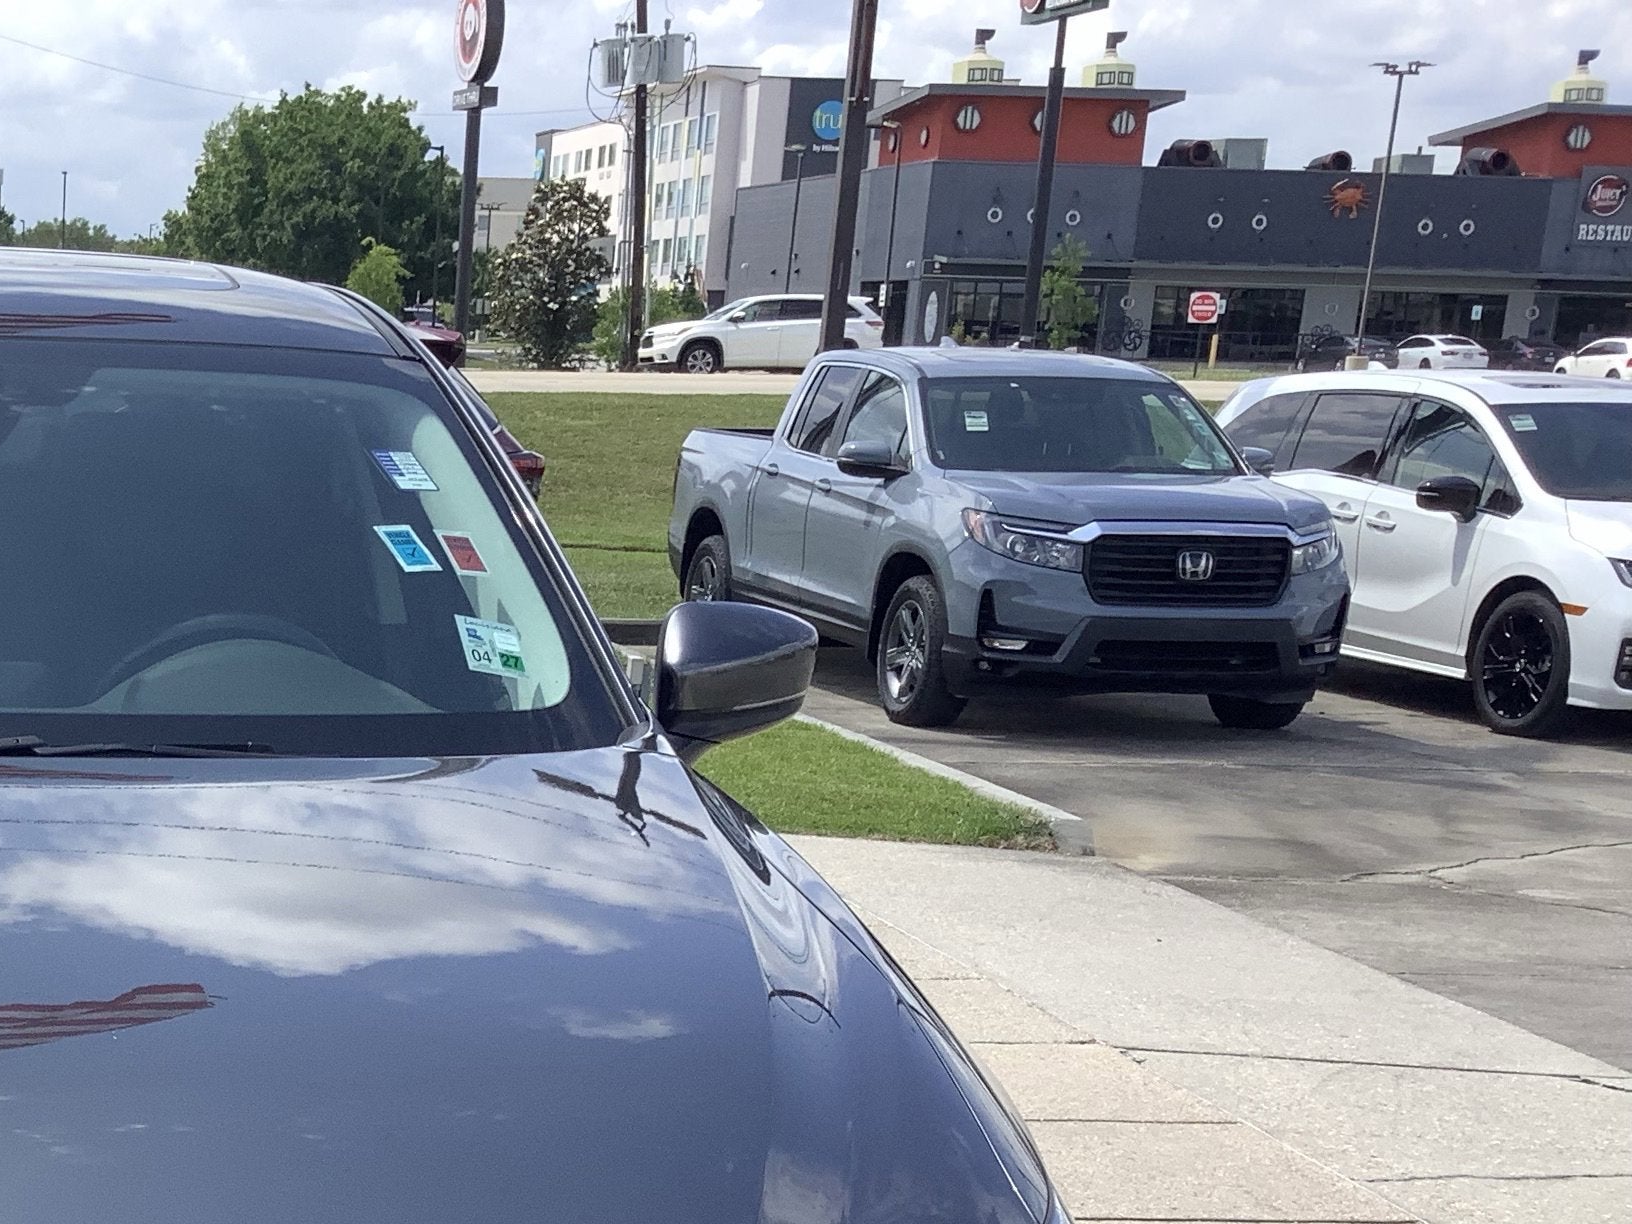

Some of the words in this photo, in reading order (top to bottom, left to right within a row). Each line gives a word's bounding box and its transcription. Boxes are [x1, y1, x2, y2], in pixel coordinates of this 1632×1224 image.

[814, 107, 843, 129] tru
[471, 648, 492, 664] 04
[500, 654, 520, 668] 27
